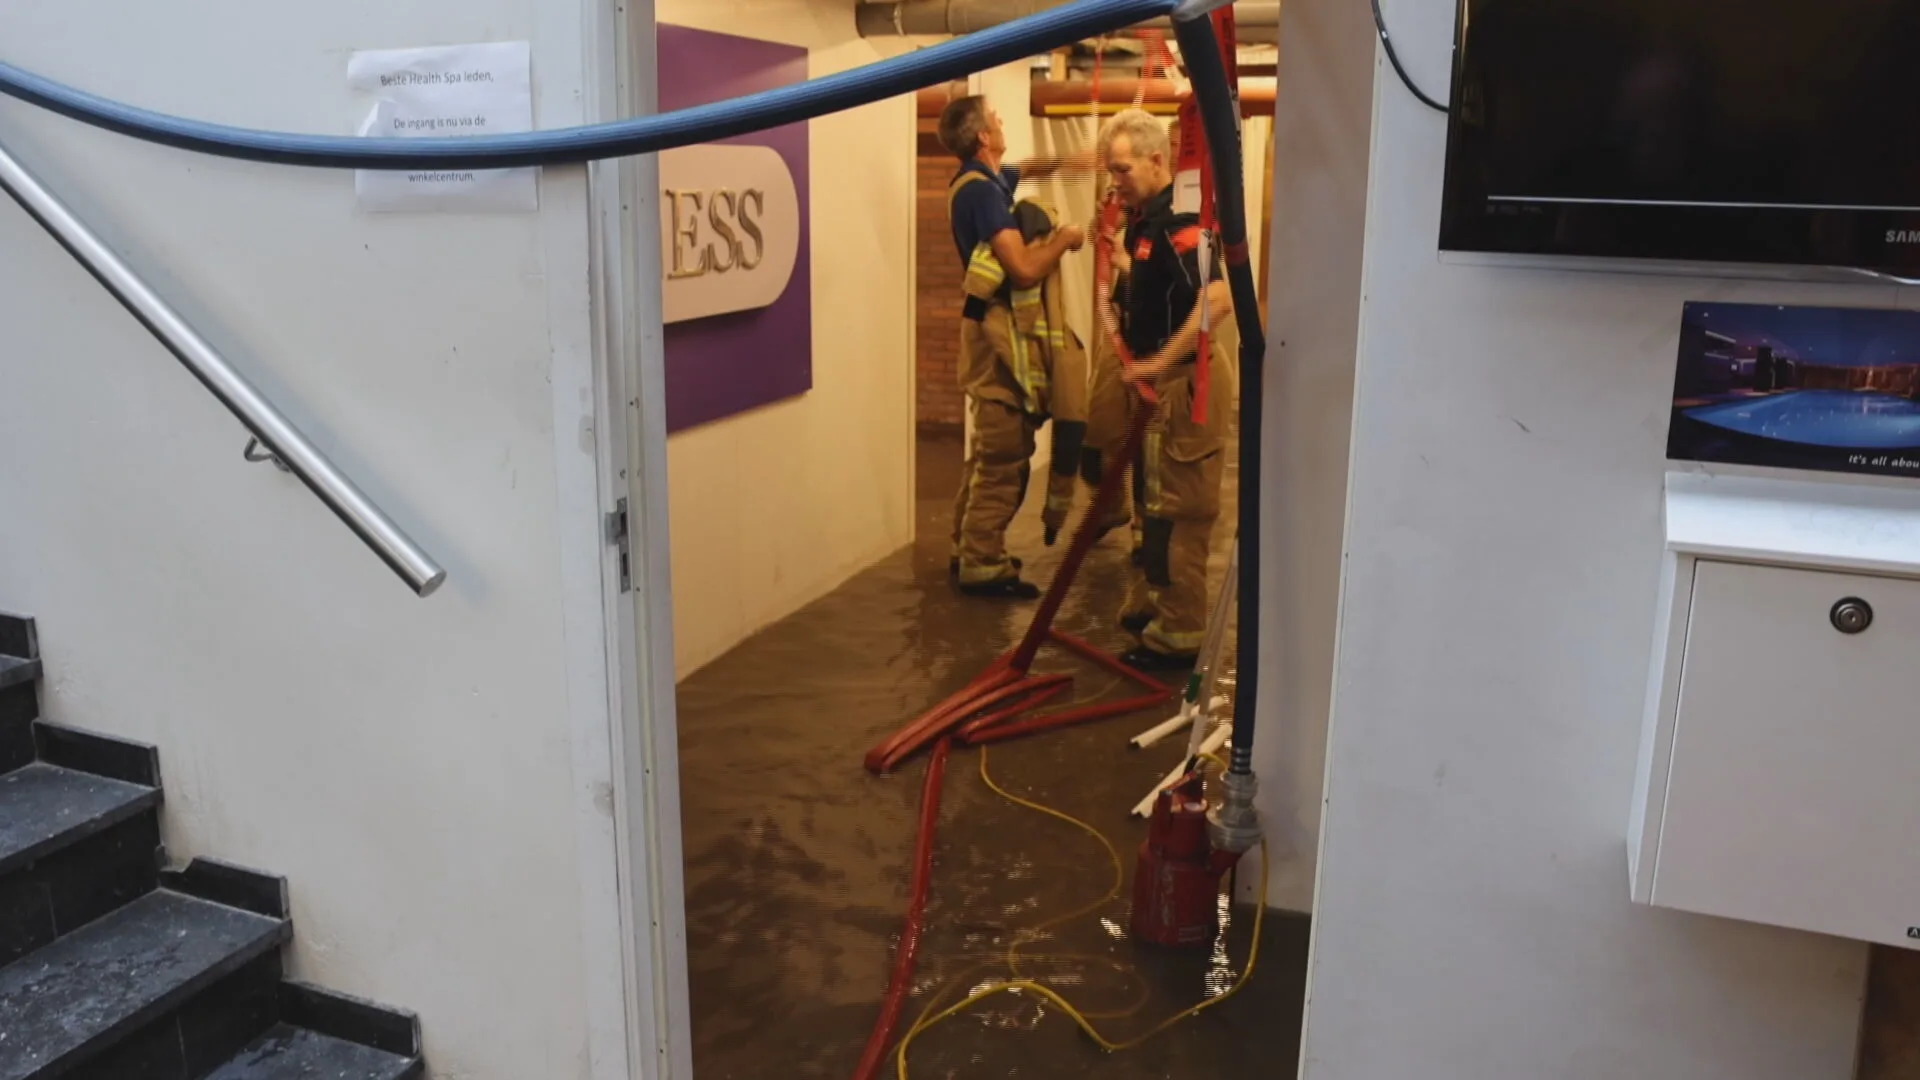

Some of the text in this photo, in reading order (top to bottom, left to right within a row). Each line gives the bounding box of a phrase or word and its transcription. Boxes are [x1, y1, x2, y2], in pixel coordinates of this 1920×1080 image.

[380, 70, 494, 86] Beste Health Spa leden,
[394, 115, 486, 130] De ingang is nu via de
[665, 187, 764, 280] ESS
[1871, 456, 1887, 467] all
